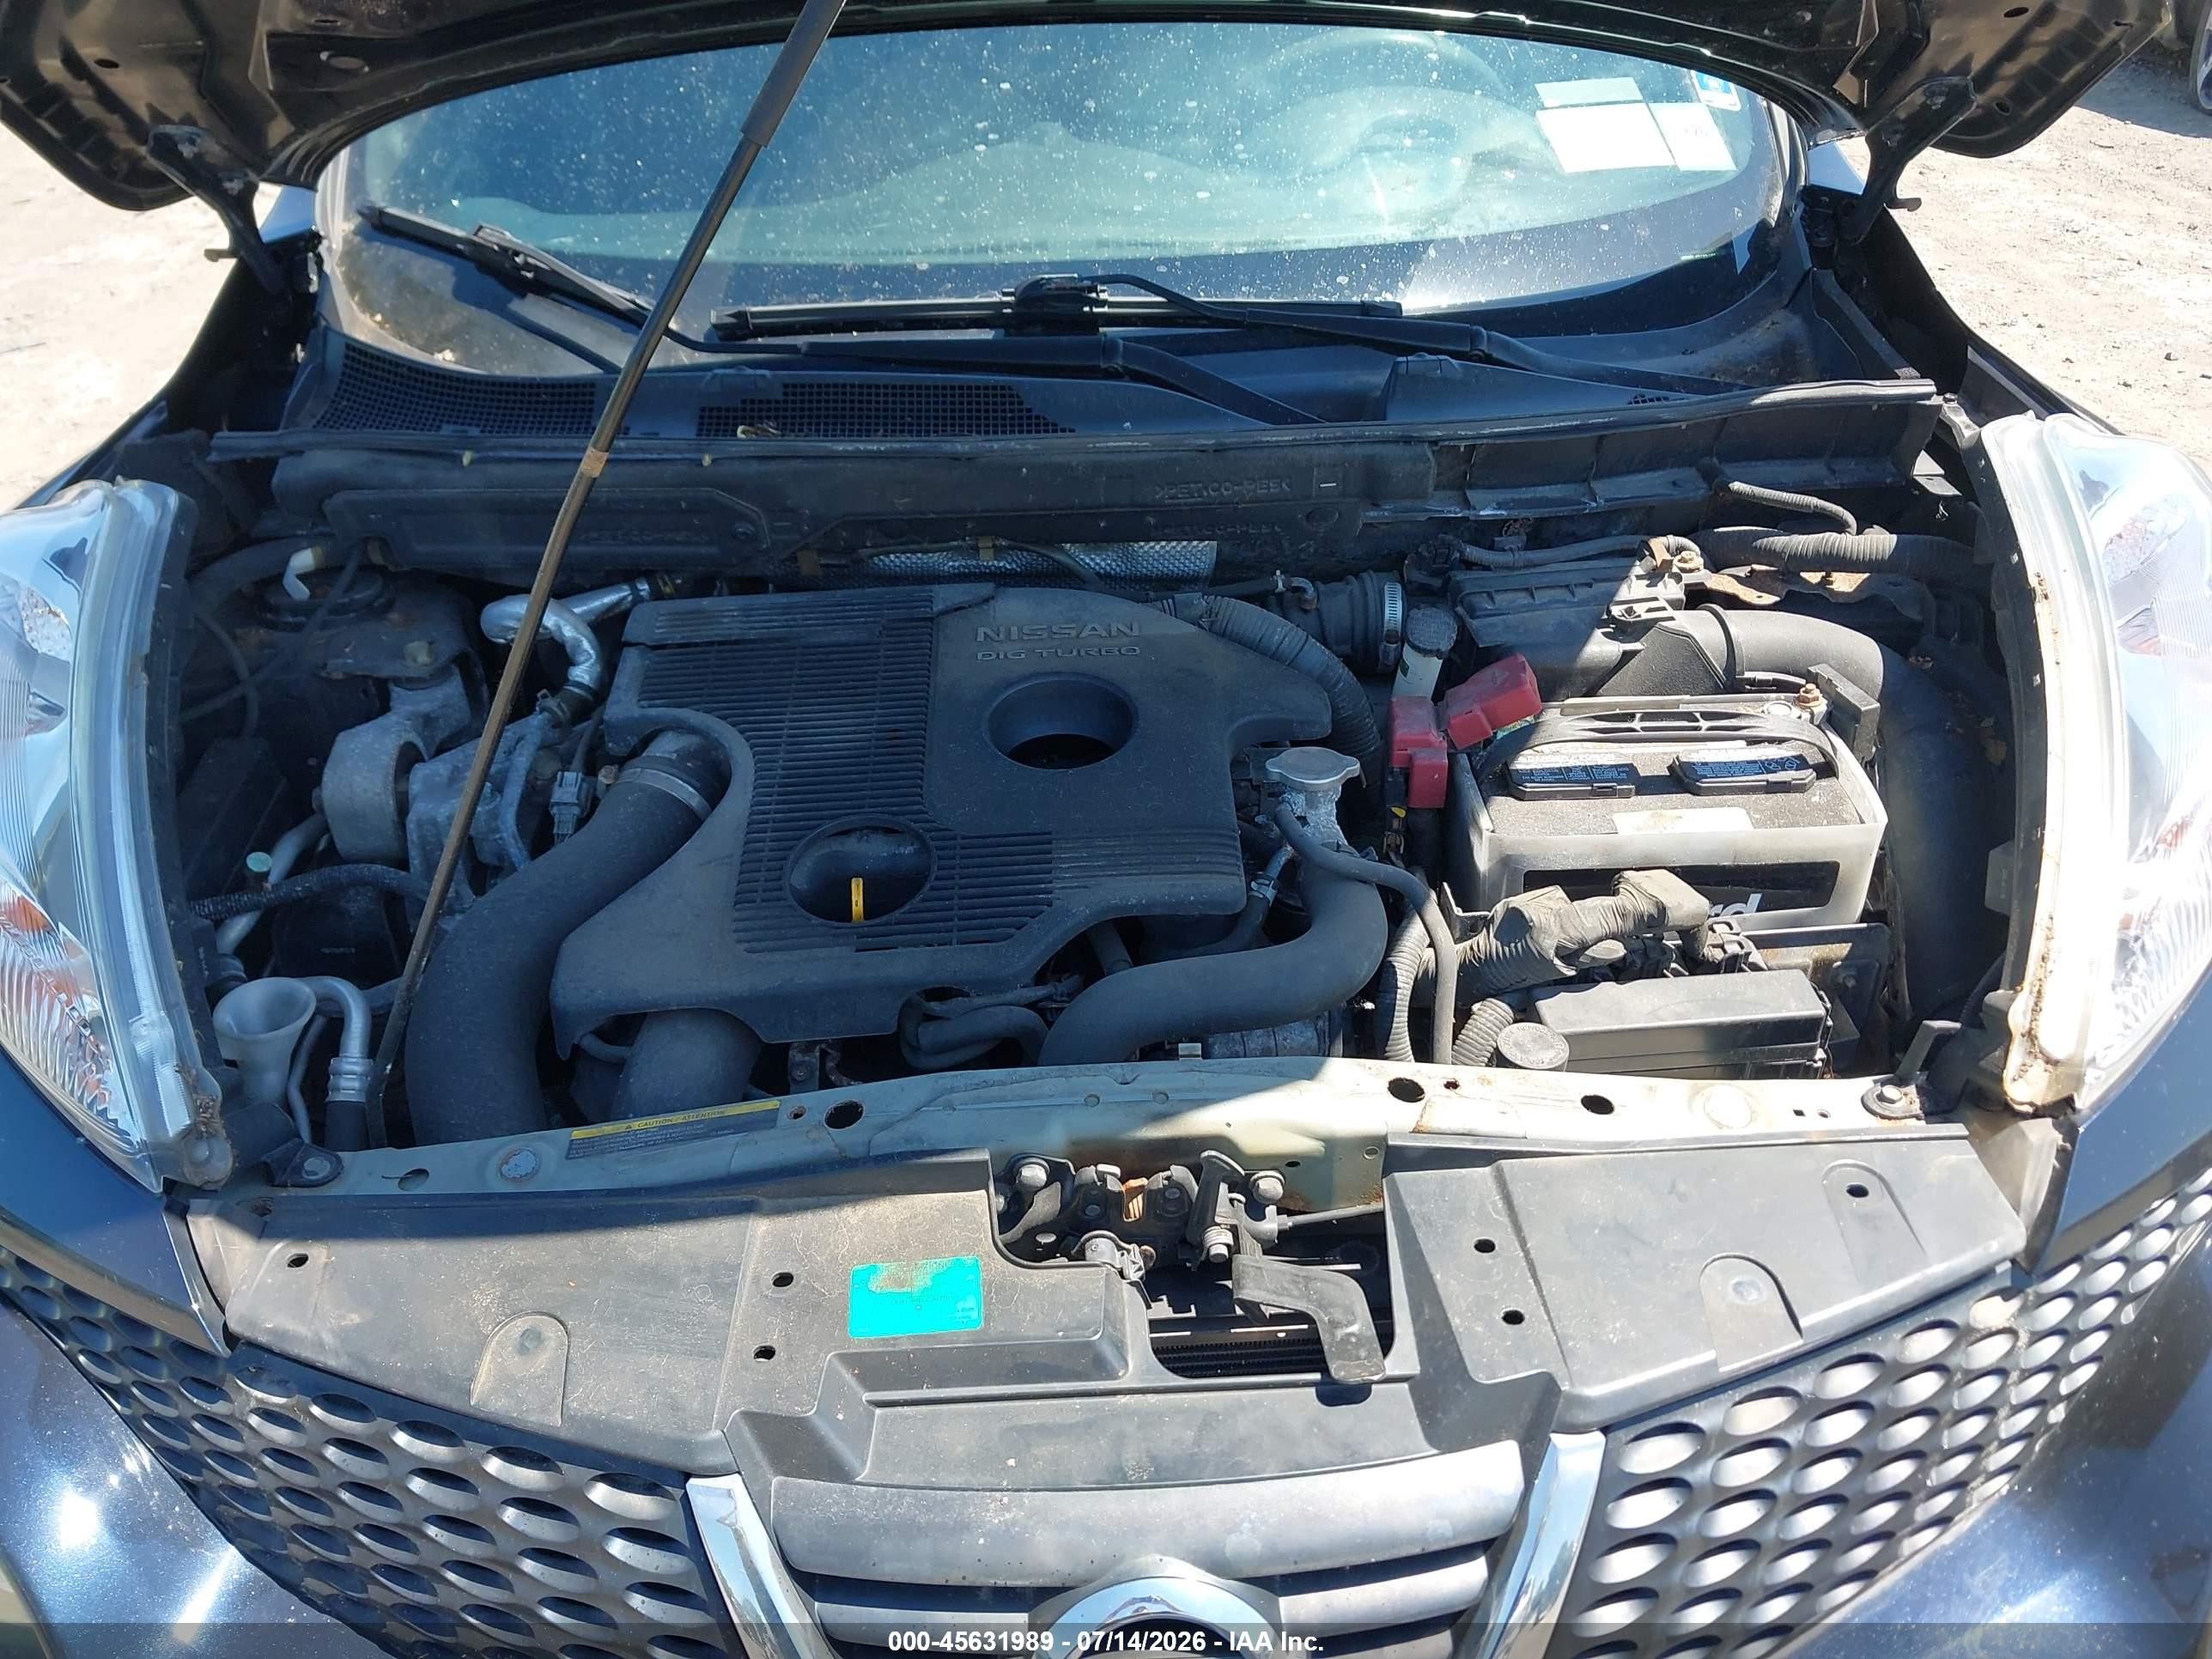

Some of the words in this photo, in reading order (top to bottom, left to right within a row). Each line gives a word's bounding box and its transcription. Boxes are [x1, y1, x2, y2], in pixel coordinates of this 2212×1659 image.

[976, 623, 1140, 641] NISSAN
[976, 649, 1026, 660] DIG
[1035, 646, 1140, 658] TURBO
[637, 1117, 673, 1128] CAUTION
